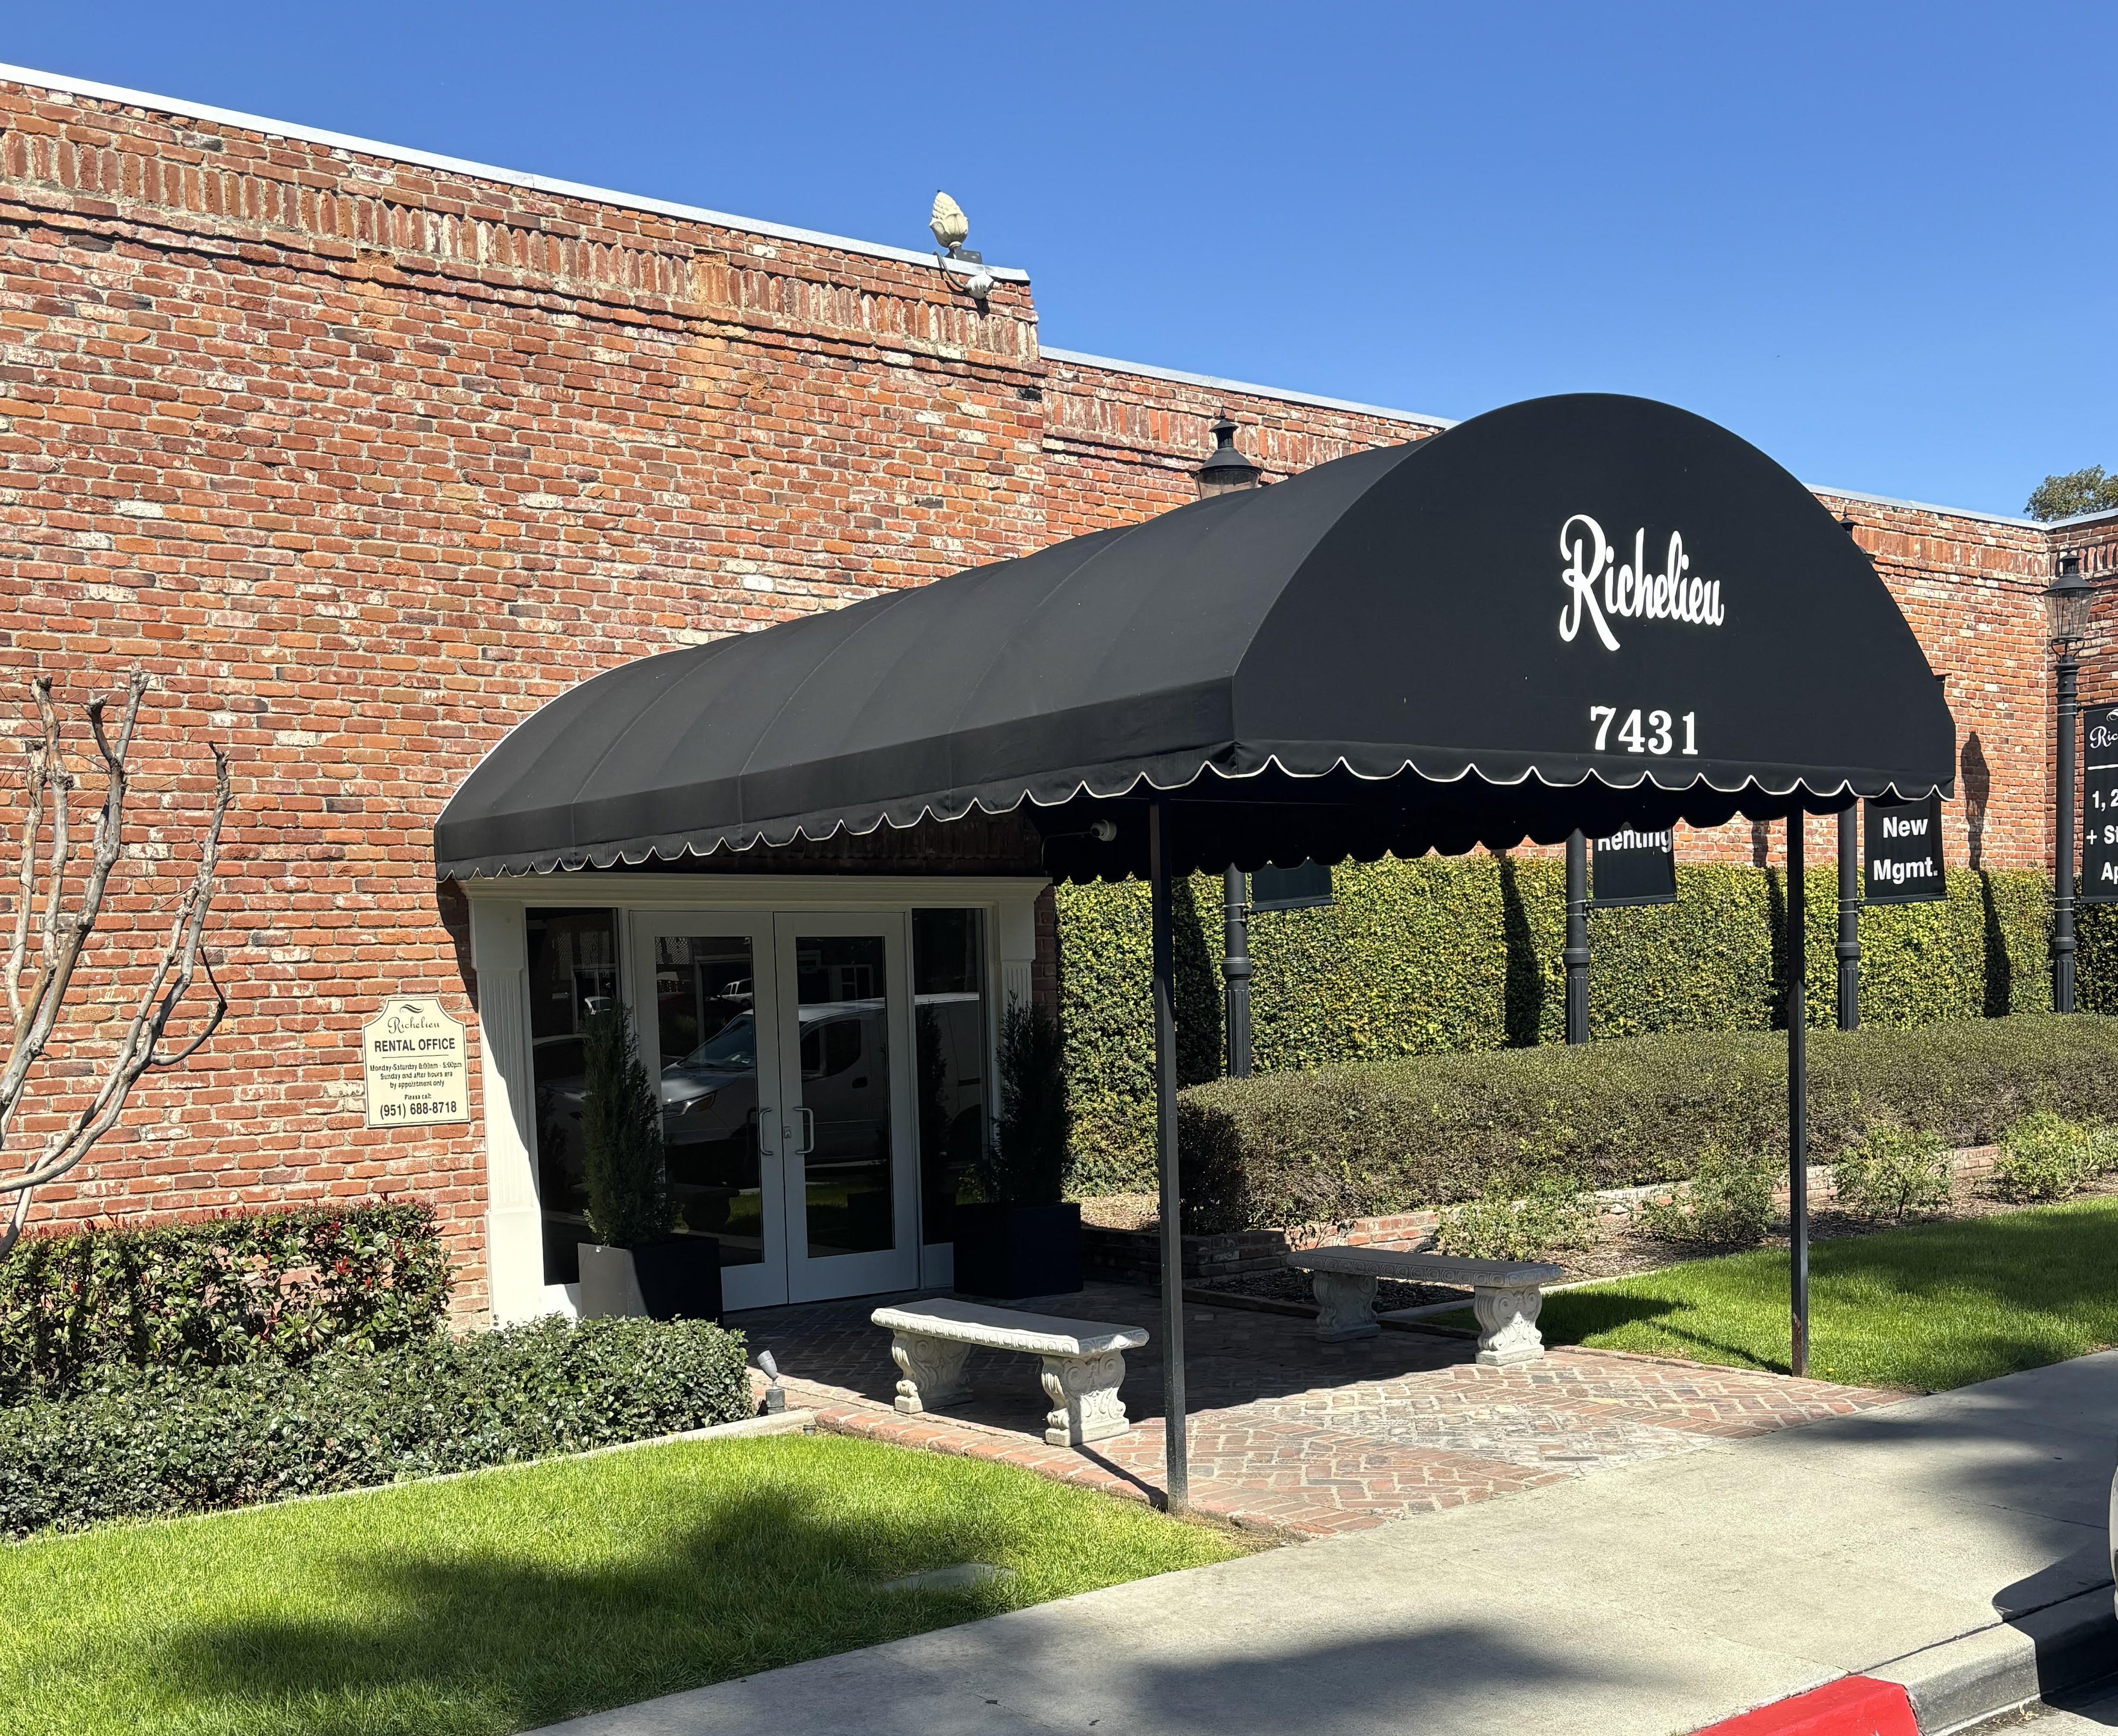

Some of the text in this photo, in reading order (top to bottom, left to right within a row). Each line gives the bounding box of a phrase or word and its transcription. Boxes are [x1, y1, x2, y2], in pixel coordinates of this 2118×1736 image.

[1559, 514, 1725, 651] Richelieu
[1590, 706, 1698, 755] 7431
[1883, 817, 1928, 838] New
[1873, 857, 1938, 884] Mgmt.
[388, 1016, 440, 1034] Richelieu
[374, 1038, 456, 1052] RENTAL OFFICE
[398, 1080, 432, 1089] appointment
[380, 1101, 457, 1120] (951) 688-8718
